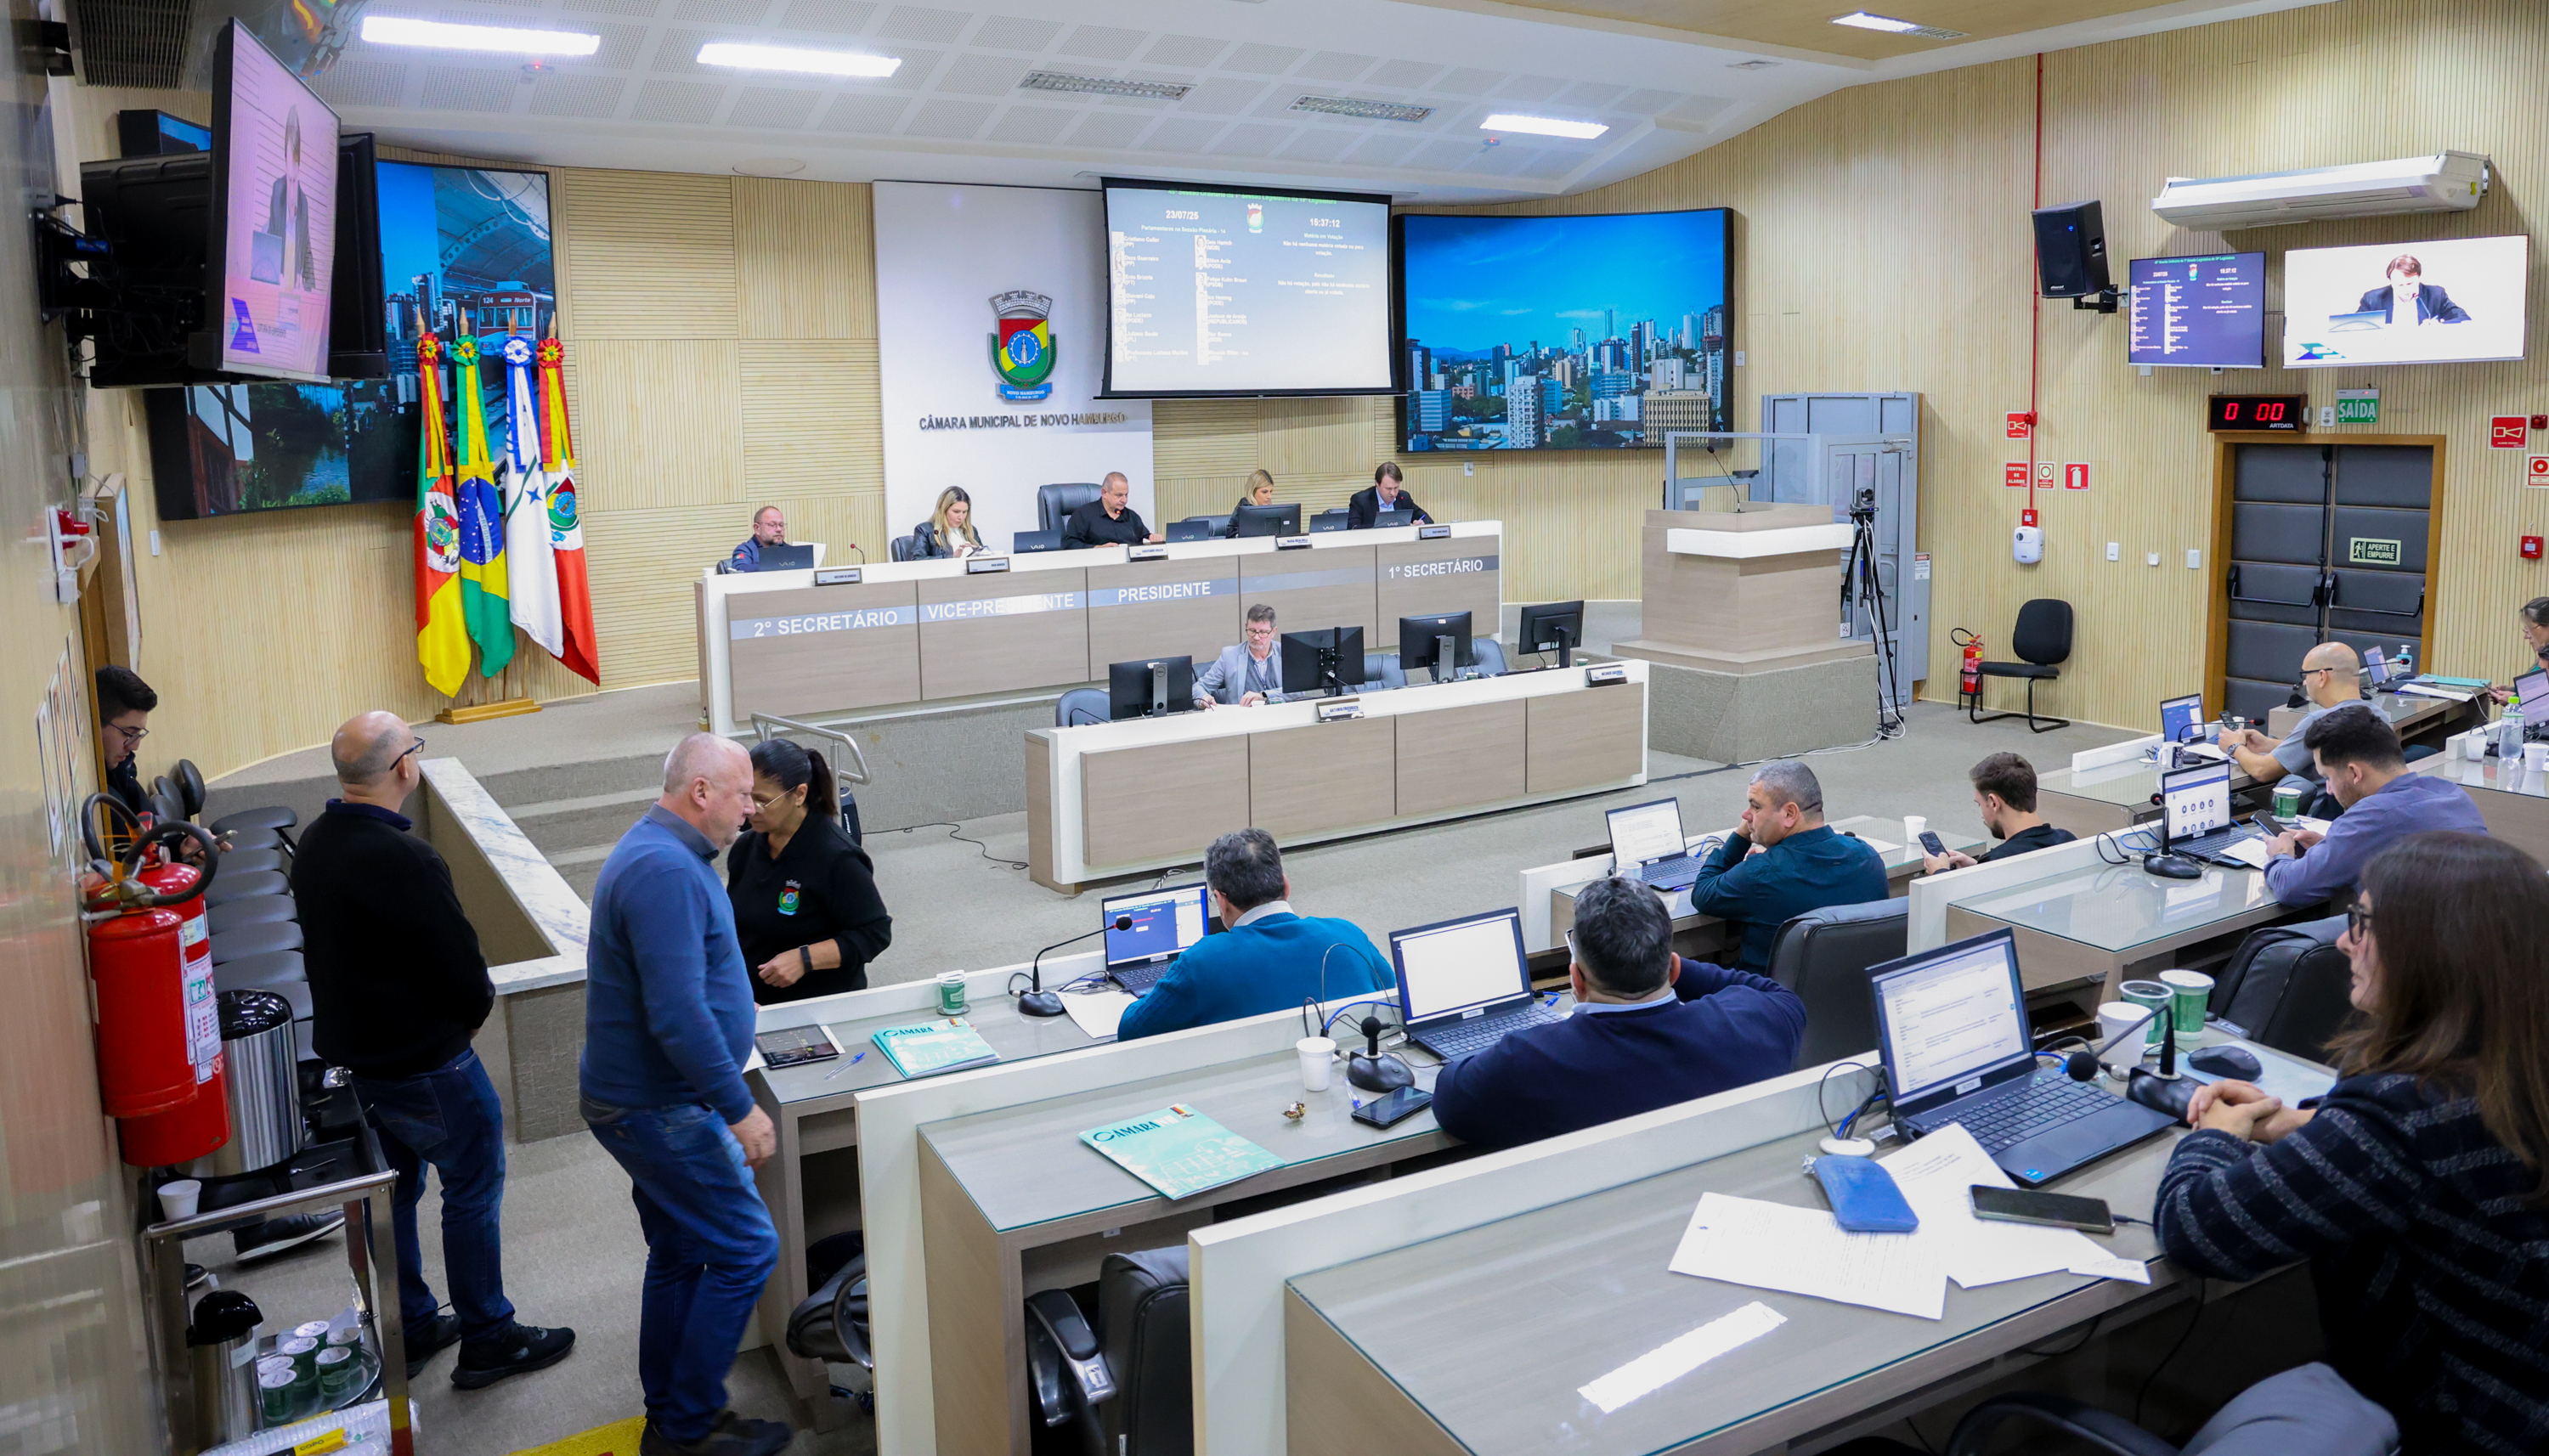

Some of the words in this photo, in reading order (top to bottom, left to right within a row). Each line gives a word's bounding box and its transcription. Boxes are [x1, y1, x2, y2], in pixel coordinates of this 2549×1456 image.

[1166, 210, 1199, 220] 23/07/25
[1309, 218, 1341, 228] 15:37:12
[2224, 403, 2239, 420] 0
[2256, 403, 2285, 421] 00
[2338, 399, 2377, 419] SAÍDA
[919, 414, 966, 431] CÂMARA
[969, 415, 1021, 429] MUNICIPAL
[1024, 415, 1037, 427] DE
[1041, 414, 1069, 426] NOVO
[1071, 412, 1128, 426] HAMBURGO
[479, 515, 492, 560] PROGRESSO
[2367, 544, 2390, 552] APERTE
[2367, 550, 2395, 560] EMPURRE
[1404, 558, 1483, 578] SECRETÁRIO
[1118, 581, 1211, 602] PRESIDENTE
[927, 593, 1075, 619] VICE-PRESENTE
[777, 609, 898, 635] SECRETÁRIO
[300, 1439, 325, 1452] COPO
